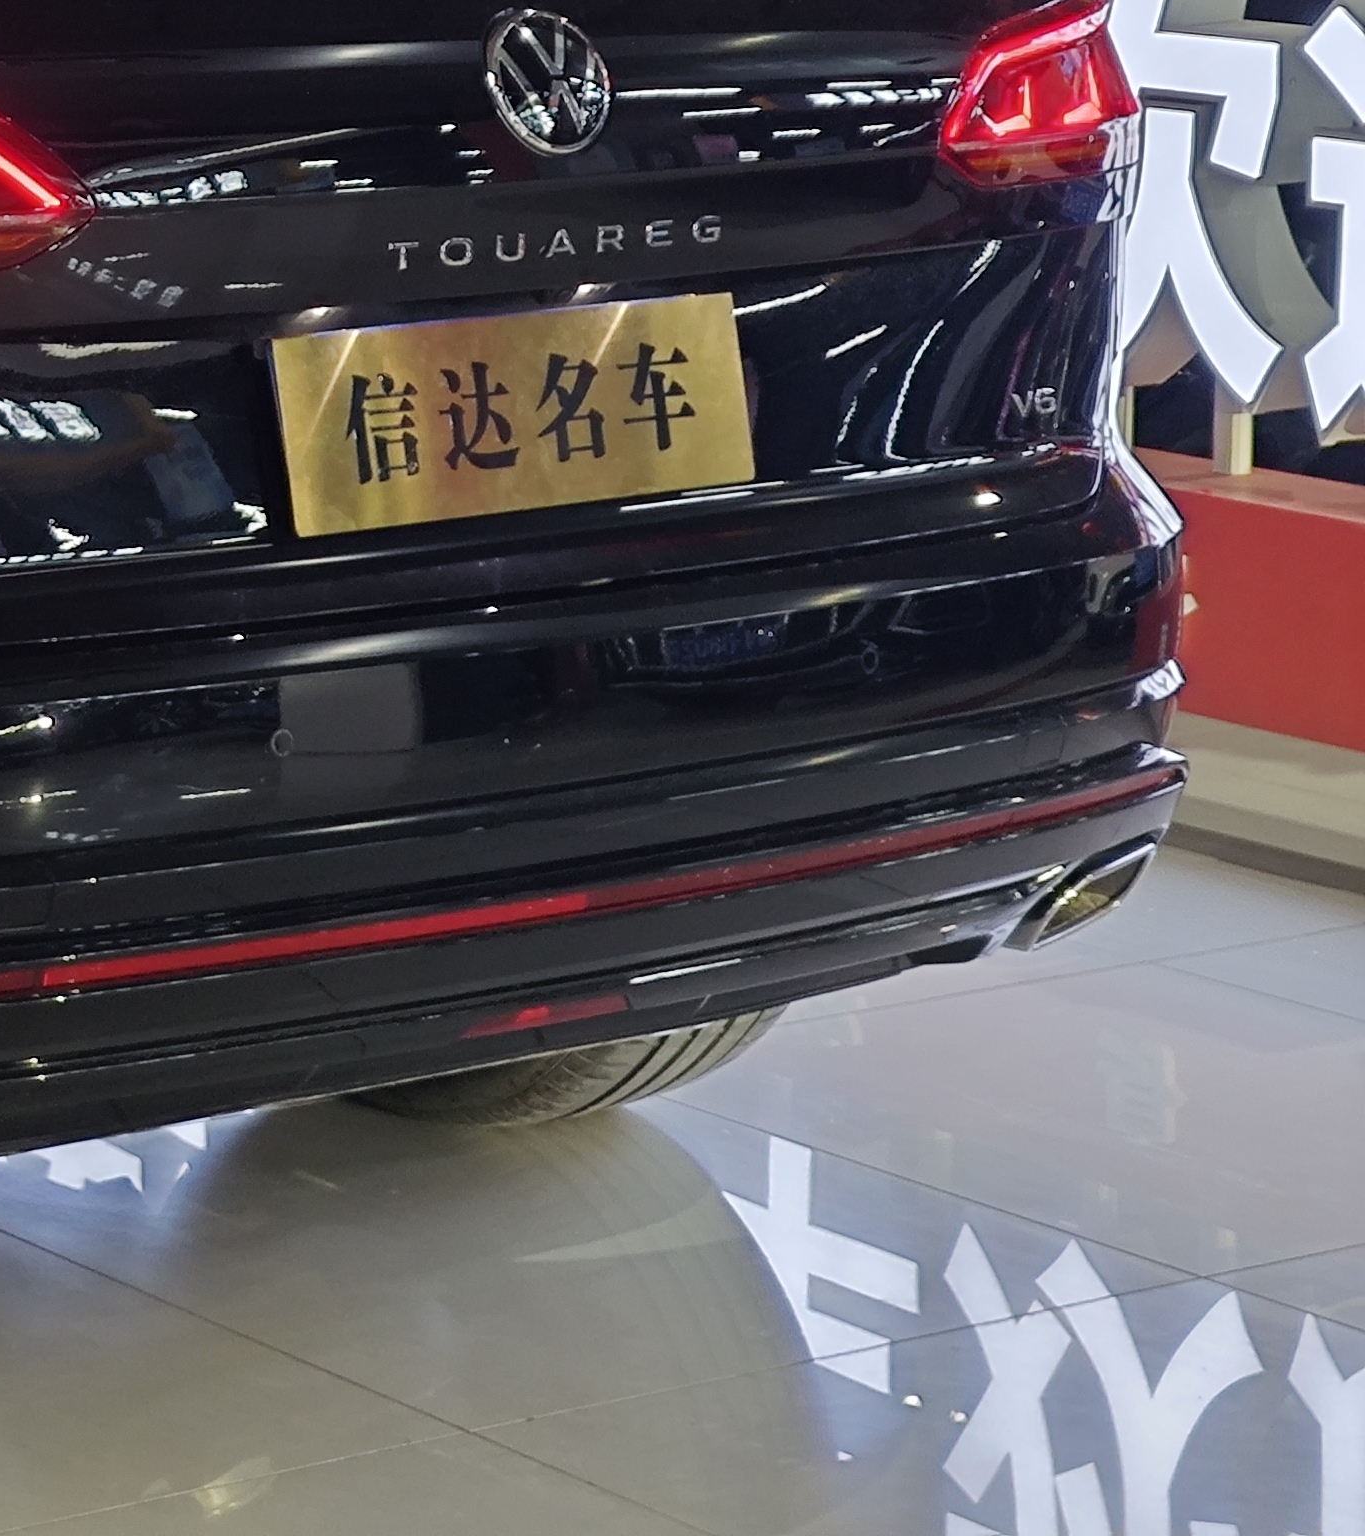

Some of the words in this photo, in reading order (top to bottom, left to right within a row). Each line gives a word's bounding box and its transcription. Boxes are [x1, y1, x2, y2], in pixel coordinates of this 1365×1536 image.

[387, 215, 722, 271] TOUAREG
[344, 341, 697, 486] 信达名车
[1011, 387, 1057, 417] V6
